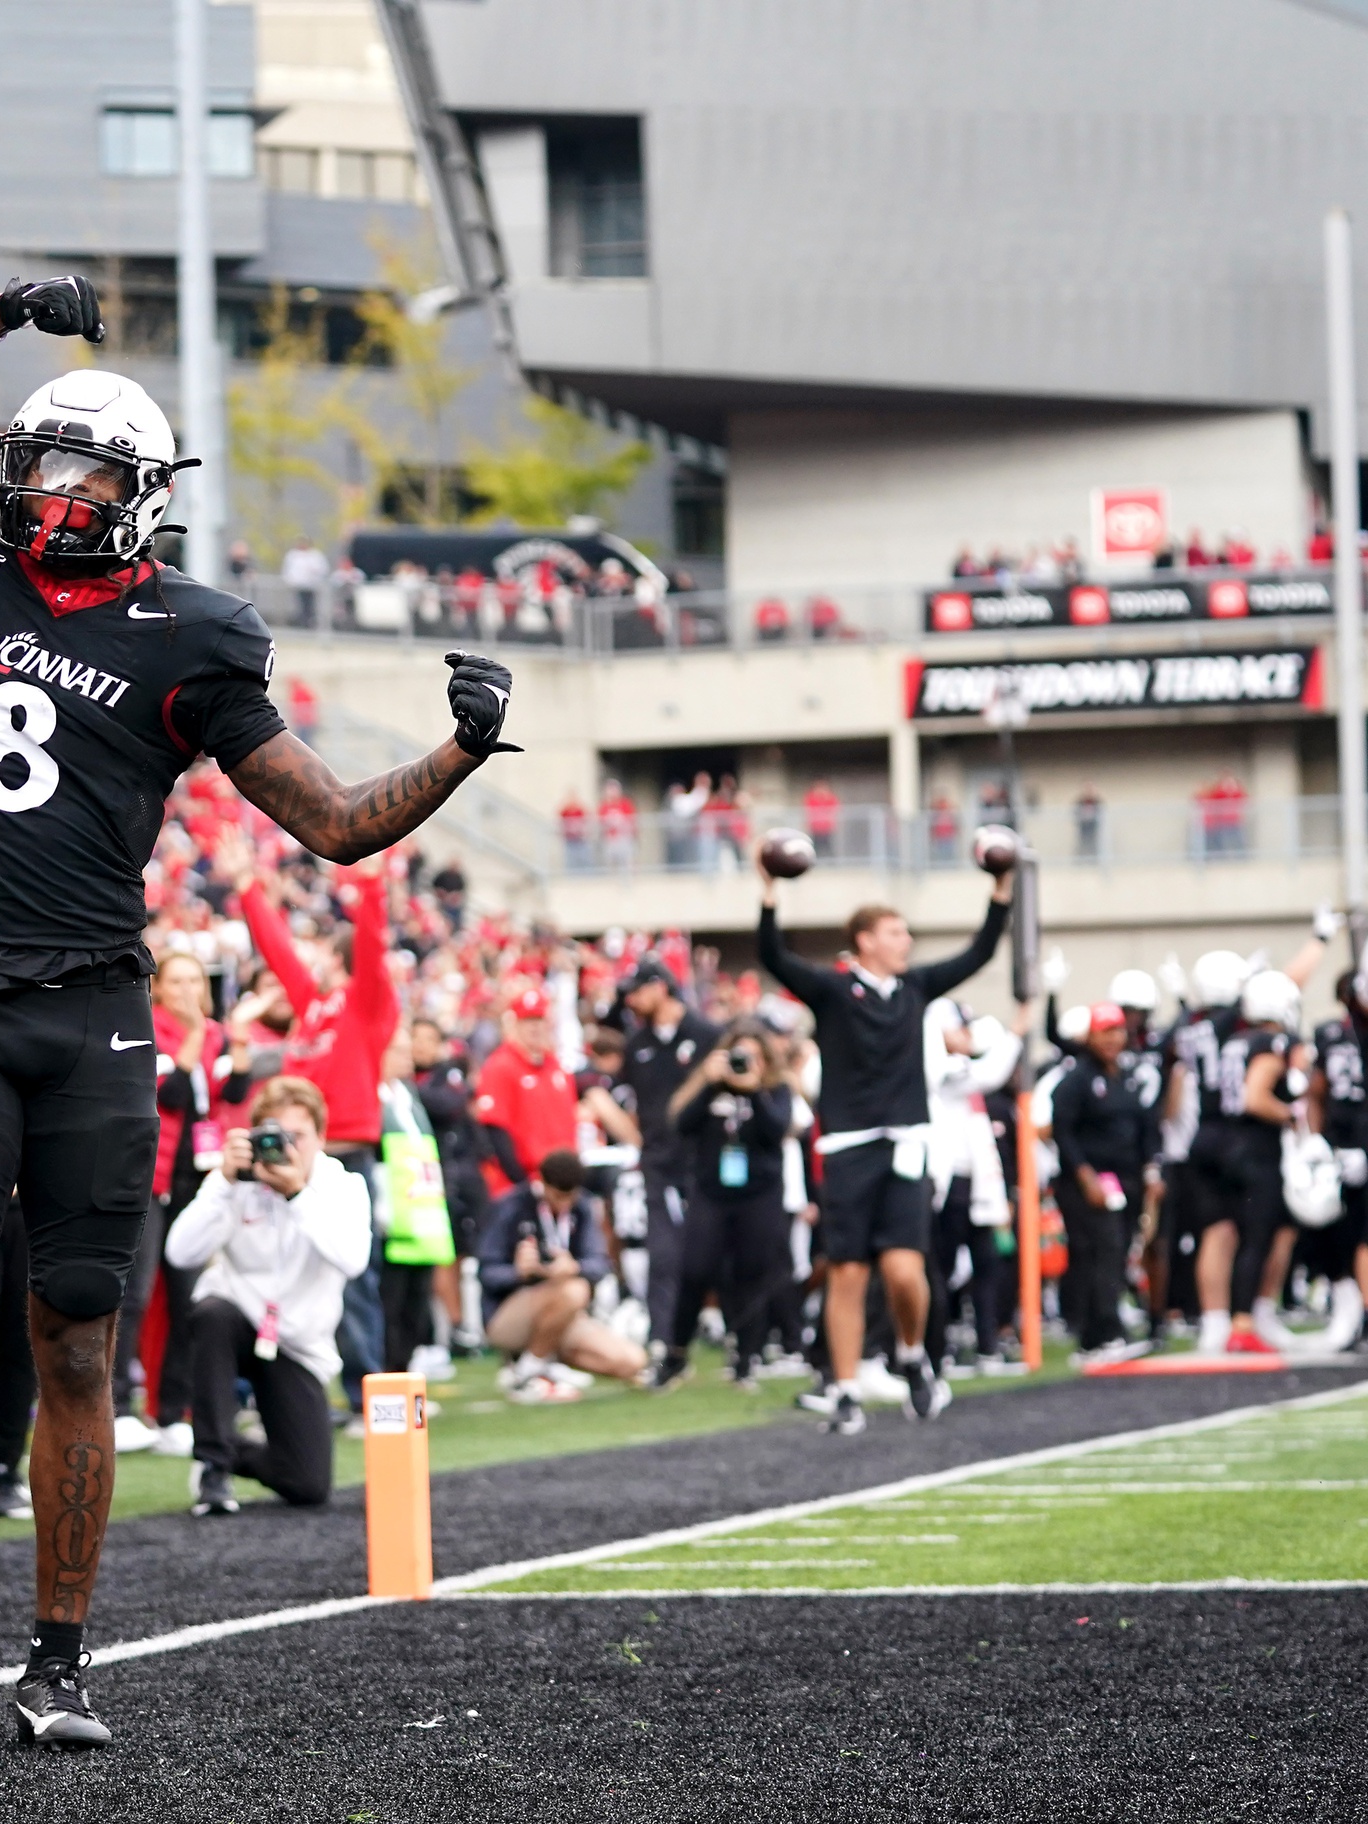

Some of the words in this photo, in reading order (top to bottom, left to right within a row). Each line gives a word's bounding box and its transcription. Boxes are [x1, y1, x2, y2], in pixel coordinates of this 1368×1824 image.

[921, 658, 1150, 713] TOUHDOWN
[1151, 653, 1305, 703] TERRACE
[50, 1442, 103, 1624] 305
